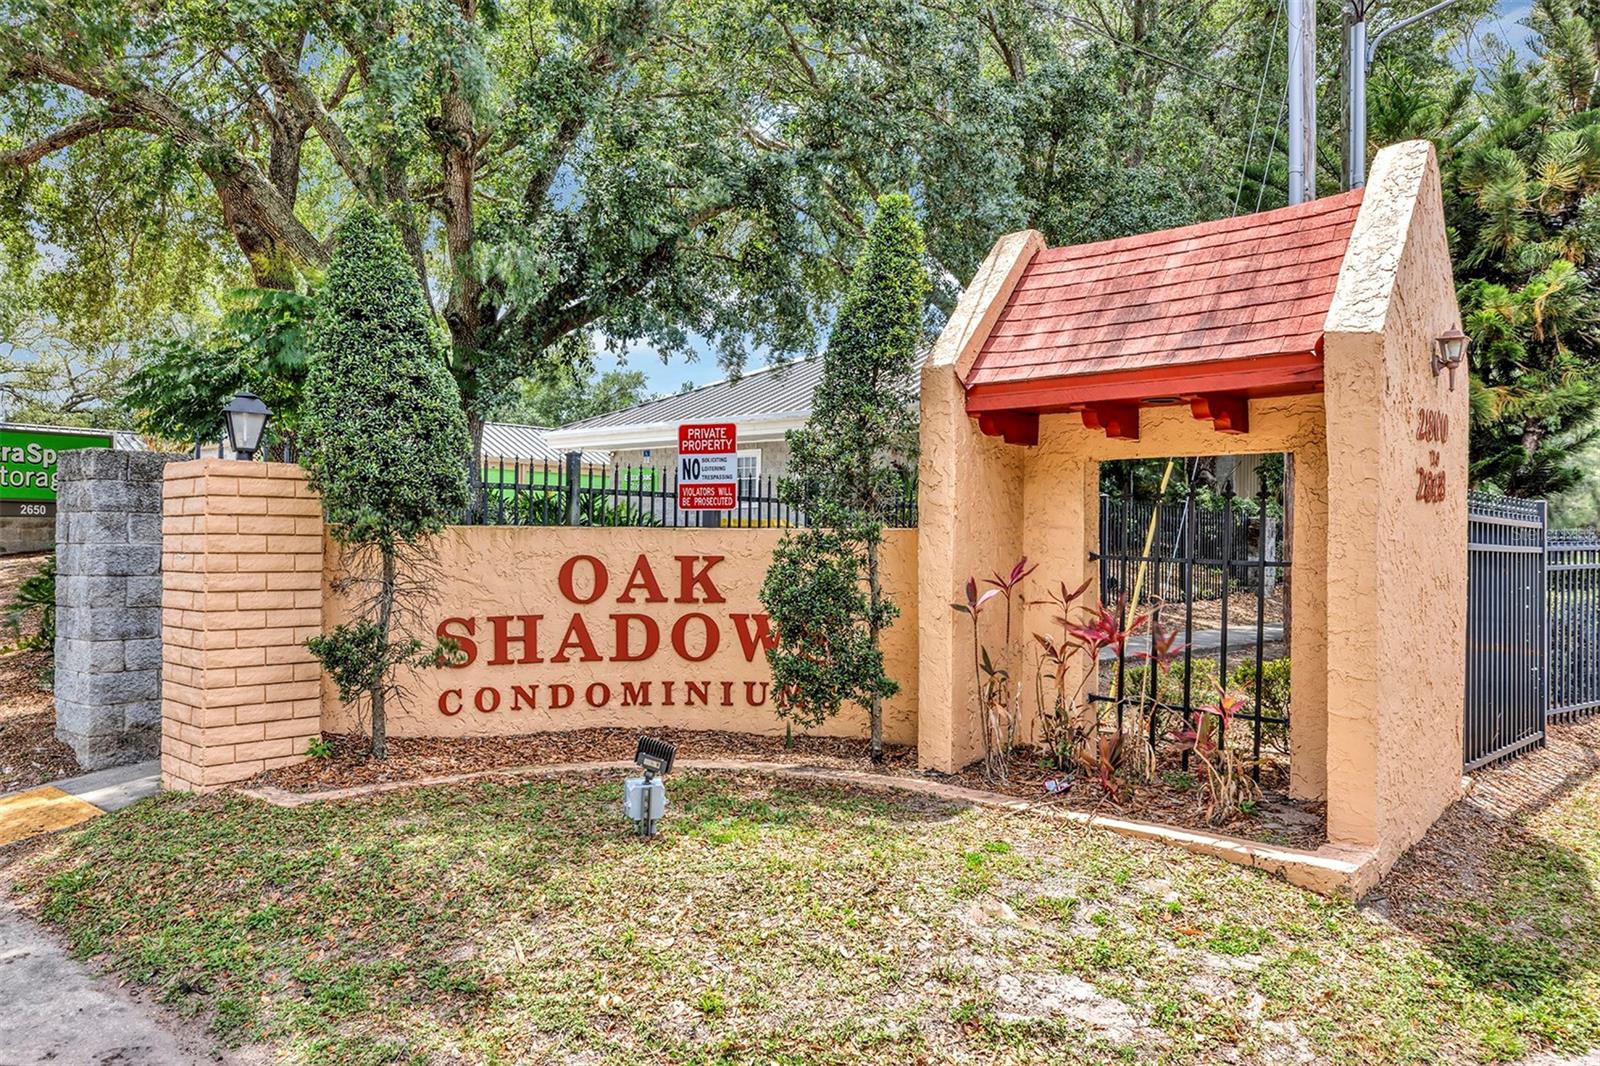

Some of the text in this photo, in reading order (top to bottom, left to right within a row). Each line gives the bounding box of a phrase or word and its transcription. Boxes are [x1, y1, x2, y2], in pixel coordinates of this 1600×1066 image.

[688, 428, 726, 439] PRIVATE
[682, 439, 733, 451] PROPERTY
[682, 458, 700, 480] NO
[682, 487, 732, 496] VIOLATORS WILL
[682, 497, 733, 506] BE PROSECUTED
[20, 505, 46, 515] 2650
[558, 554, 726, 604] OAK
[436, 612, 831, 669] SHADOW
[438, 681, 837, 716] CONDOMINIUM
